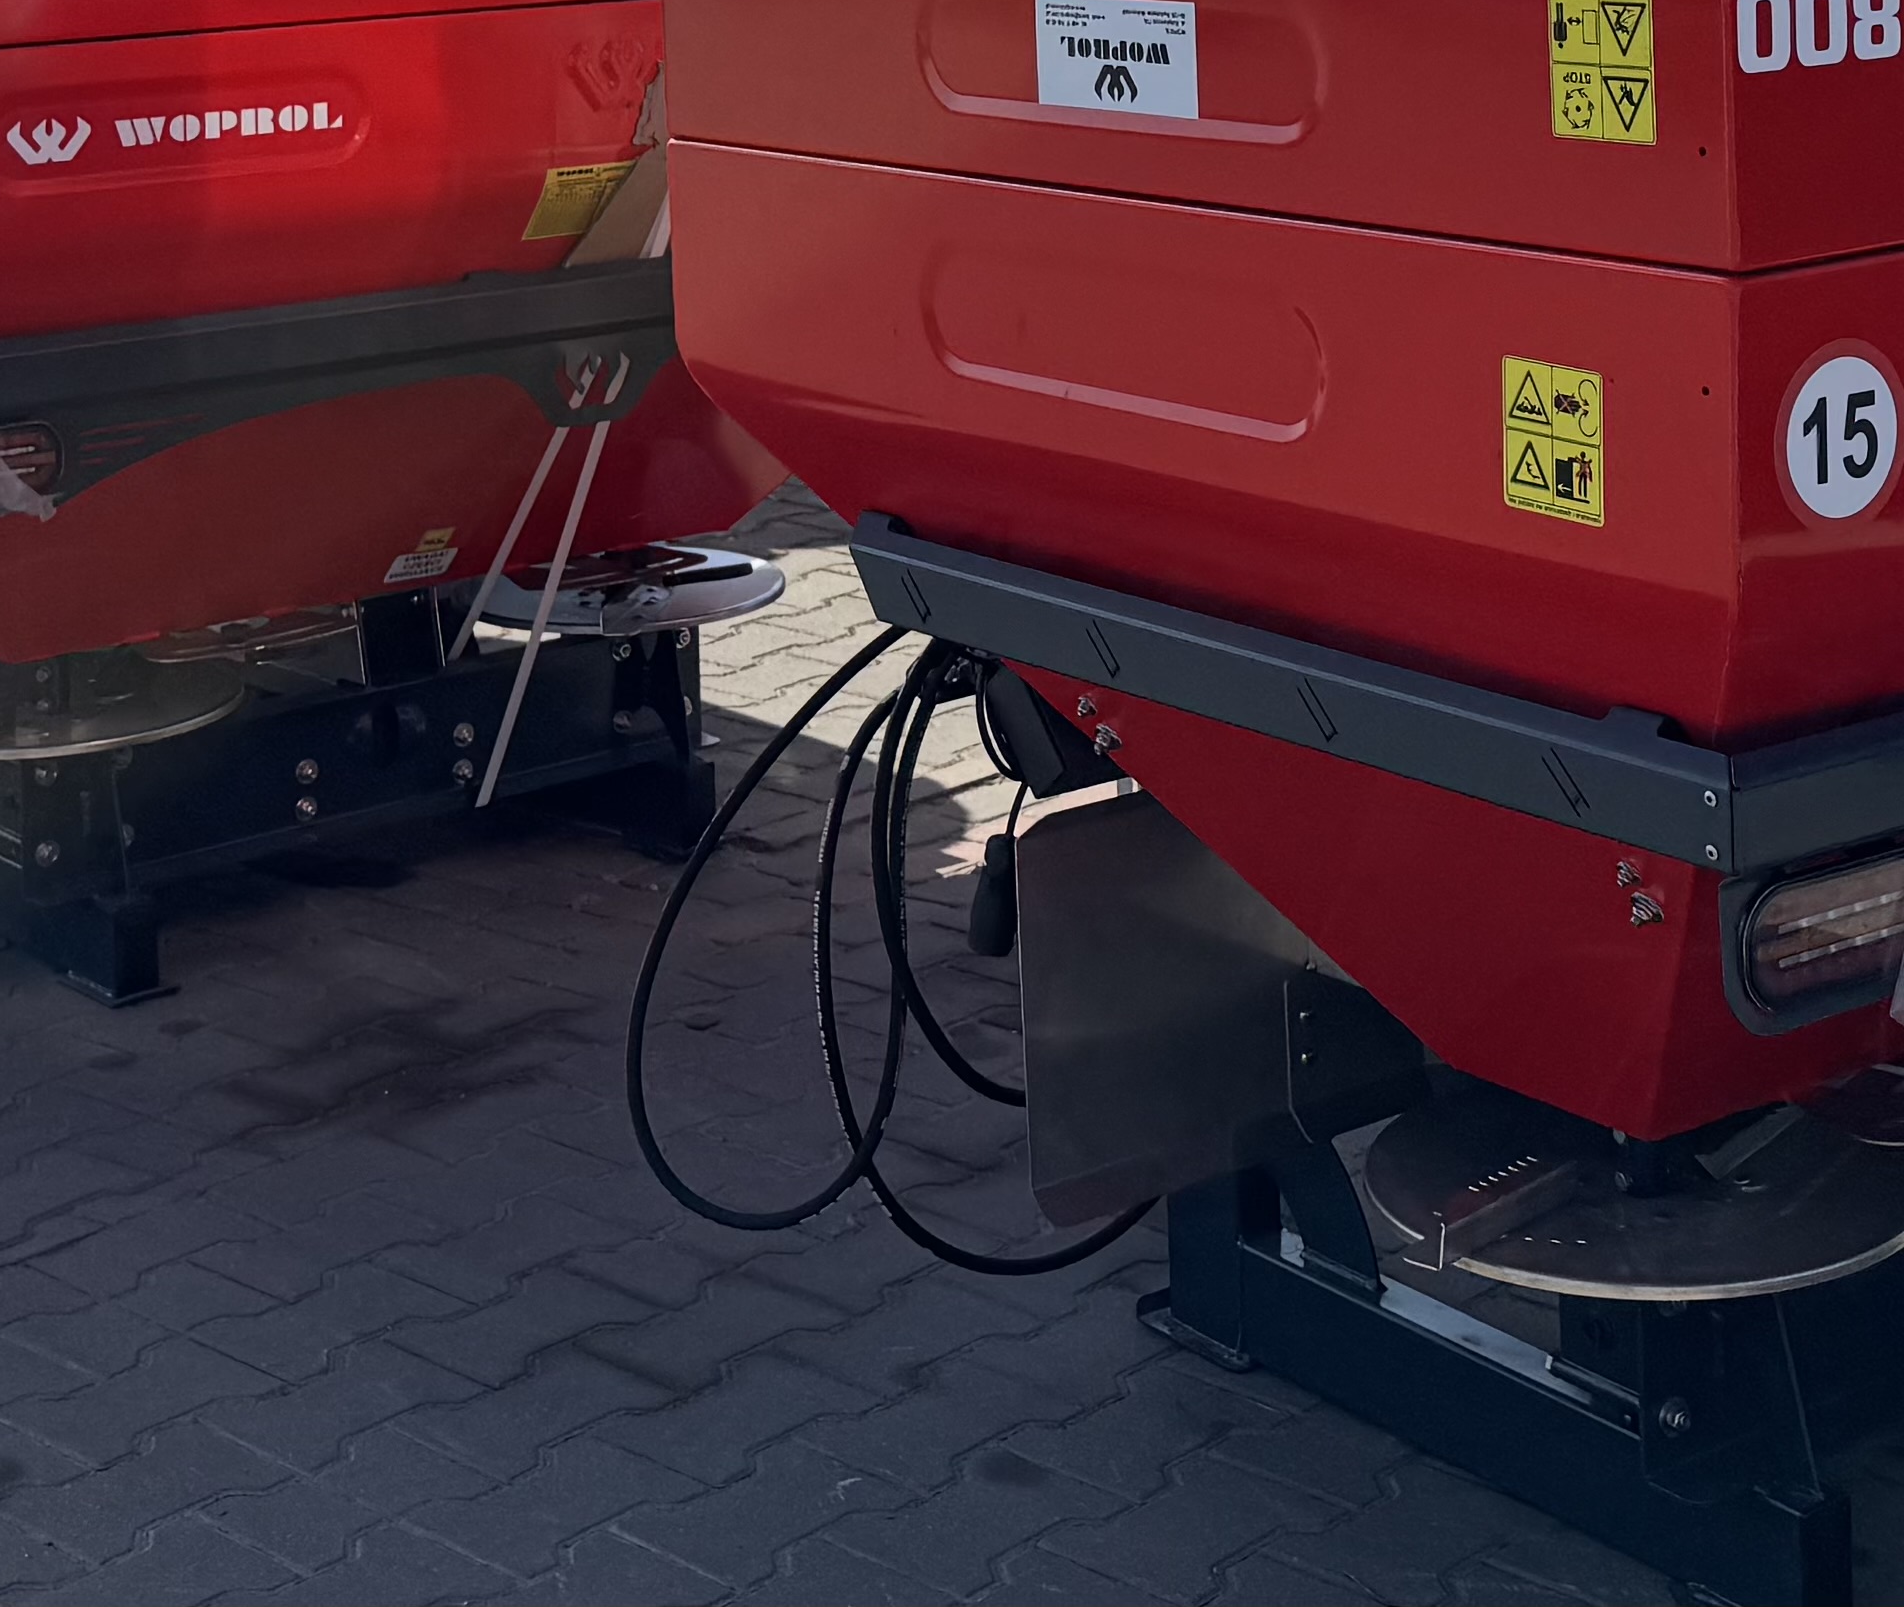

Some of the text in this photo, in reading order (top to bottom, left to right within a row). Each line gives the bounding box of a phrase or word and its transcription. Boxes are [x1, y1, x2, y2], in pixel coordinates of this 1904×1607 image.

[1060, 36, 1170, 65] WOPROL
[1562, 71, 1592, 85] STOP
[115, 101, 343, 147] WOPROL
[1801, 390, 1879, 486] 15
